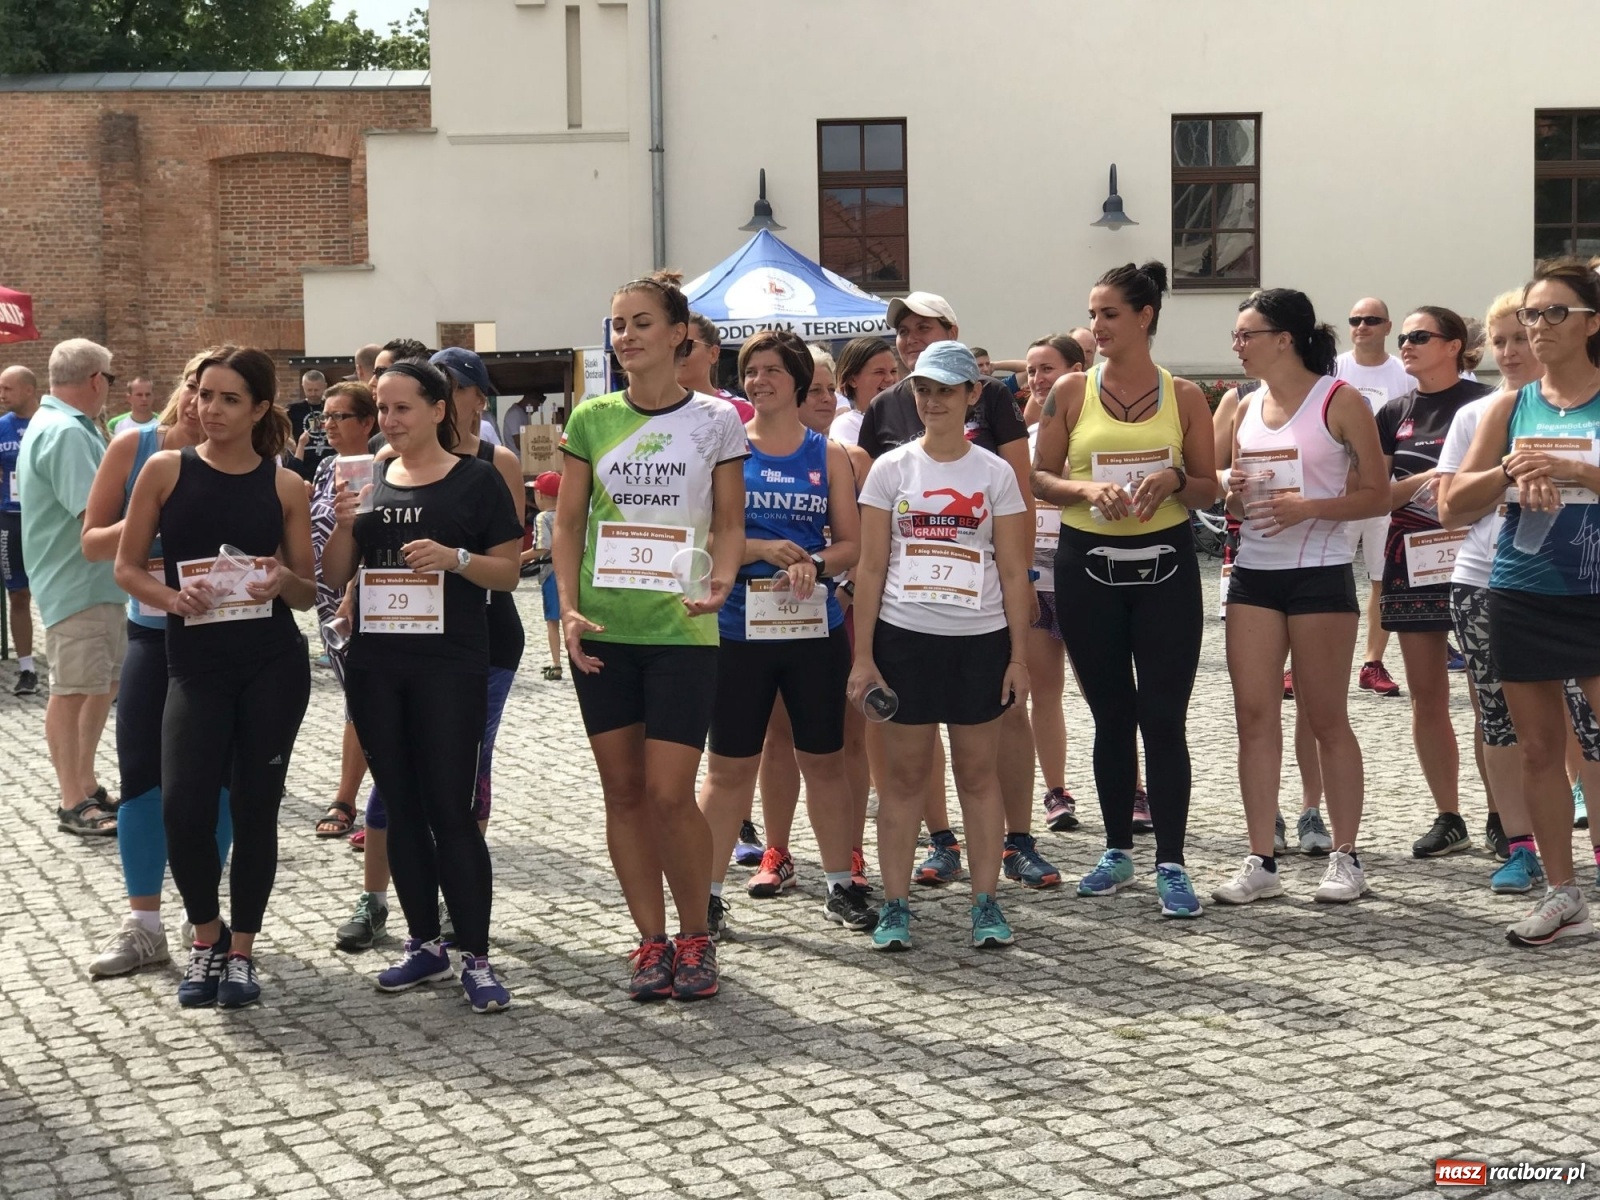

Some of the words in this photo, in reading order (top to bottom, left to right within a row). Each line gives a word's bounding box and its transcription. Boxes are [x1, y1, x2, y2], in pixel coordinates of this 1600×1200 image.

[716, 320, 795, 340] ODDZIAŁ
[609, 462, 687, 477] AKTYWNI
[625, 475, 670, 485] LYSKI
[612, 493, 681, 507] GEOFART
[382, 506, 423, 524] STAY
[790, 514, 813, 522] TEAM
[929, 516, 956, 526] BIEG
[958, 517, 978, 529] BEZ
[914, 527, 957, 537] GRANIC
[629, 546, 654, 564] 30
[1436, 548, 1456, 564] 25
[930, 564, 954, 581] 37
[387, 593, 409, 610] 29
